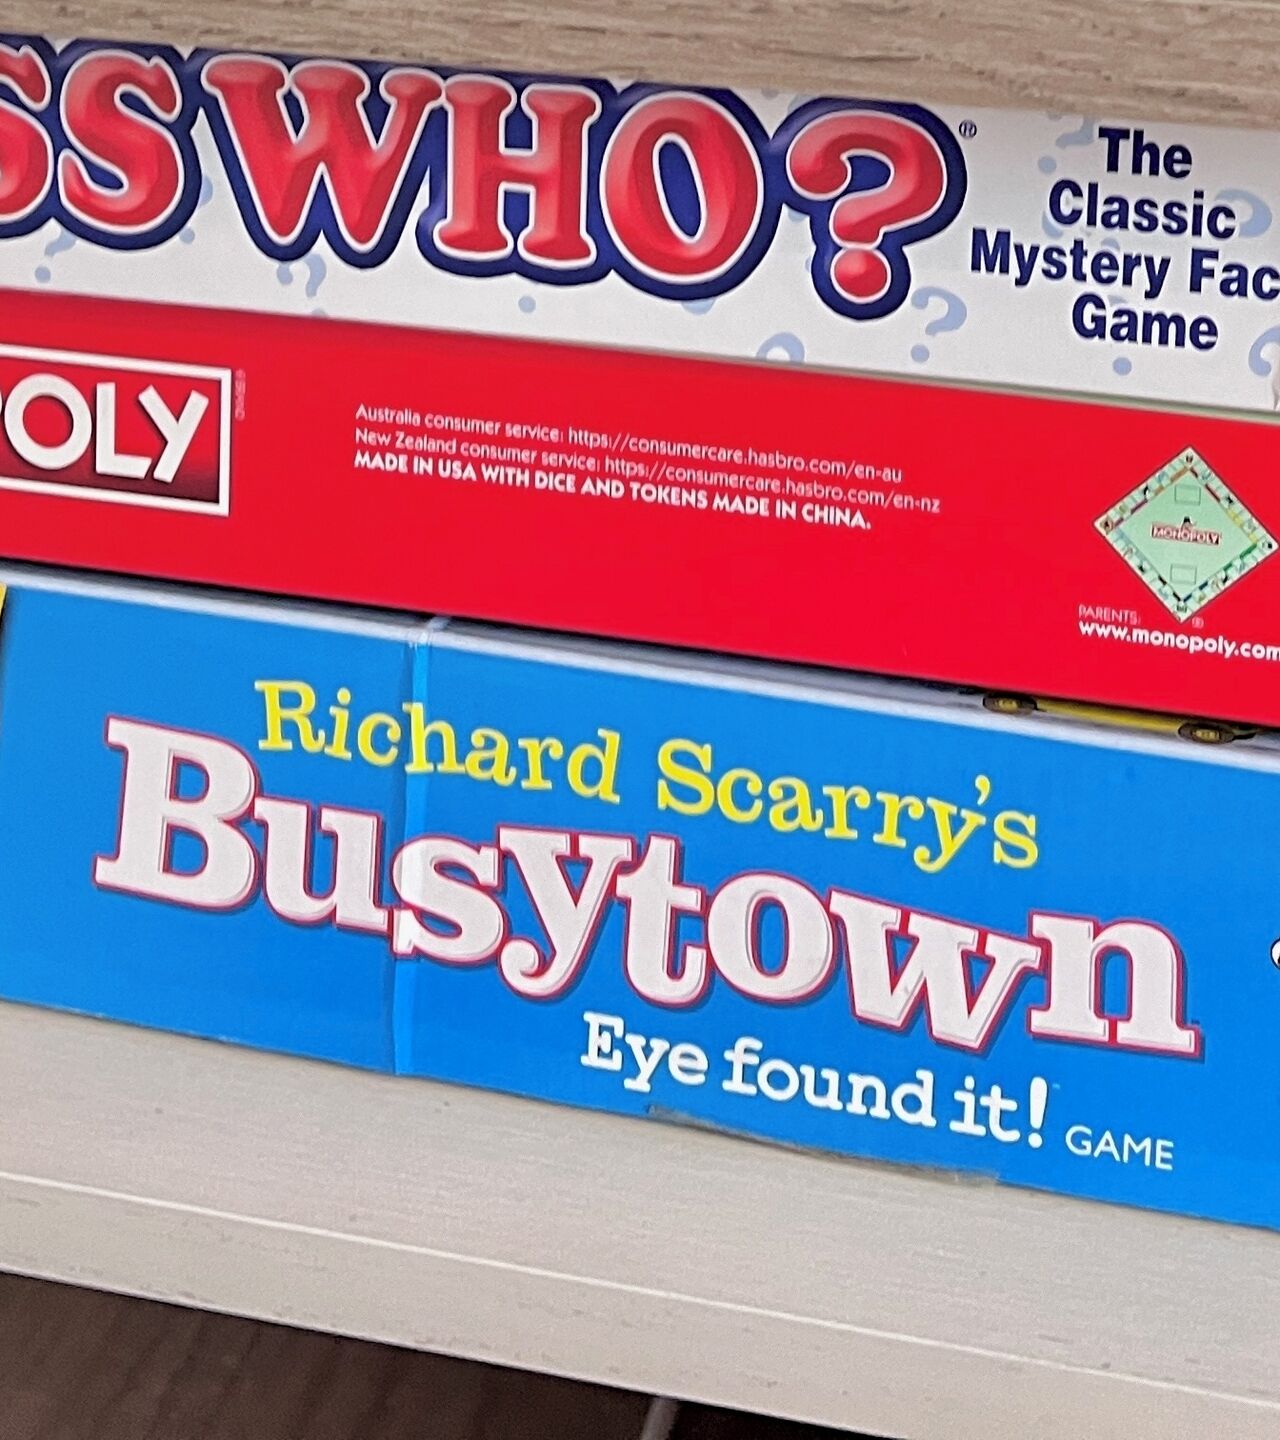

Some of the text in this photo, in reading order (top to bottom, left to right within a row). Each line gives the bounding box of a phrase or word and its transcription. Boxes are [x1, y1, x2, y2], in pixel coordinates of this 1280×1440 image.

[1097, 126, 1193, 180] The
[1048, 178, 1237, 240] Classic
[971, 227, 1172, 300] Mystery
[1071, 293, 1220, 351] Game
[355, 403, 902, 484] Australia consumer service: https://consumercare.hasbro.com/en-au
[355, 427, 941, 514] New Zealand consumer service: https://consumercare.hasbro.com/en-nz
[354, 449, 871, 530] MADE IN USA WITH DICE AND TOKENS MADE IN CHINA.
[1153, 525, 1220, 545] MONOPOLY
[1077, 603, 1141, 625] PARENTS:
[255, 678, 1040, 874] Richard Scarry's
[91, 714, 1205, 1064] Busytown
[580, 1011, 1176, 1172] Eye found it! GAME
